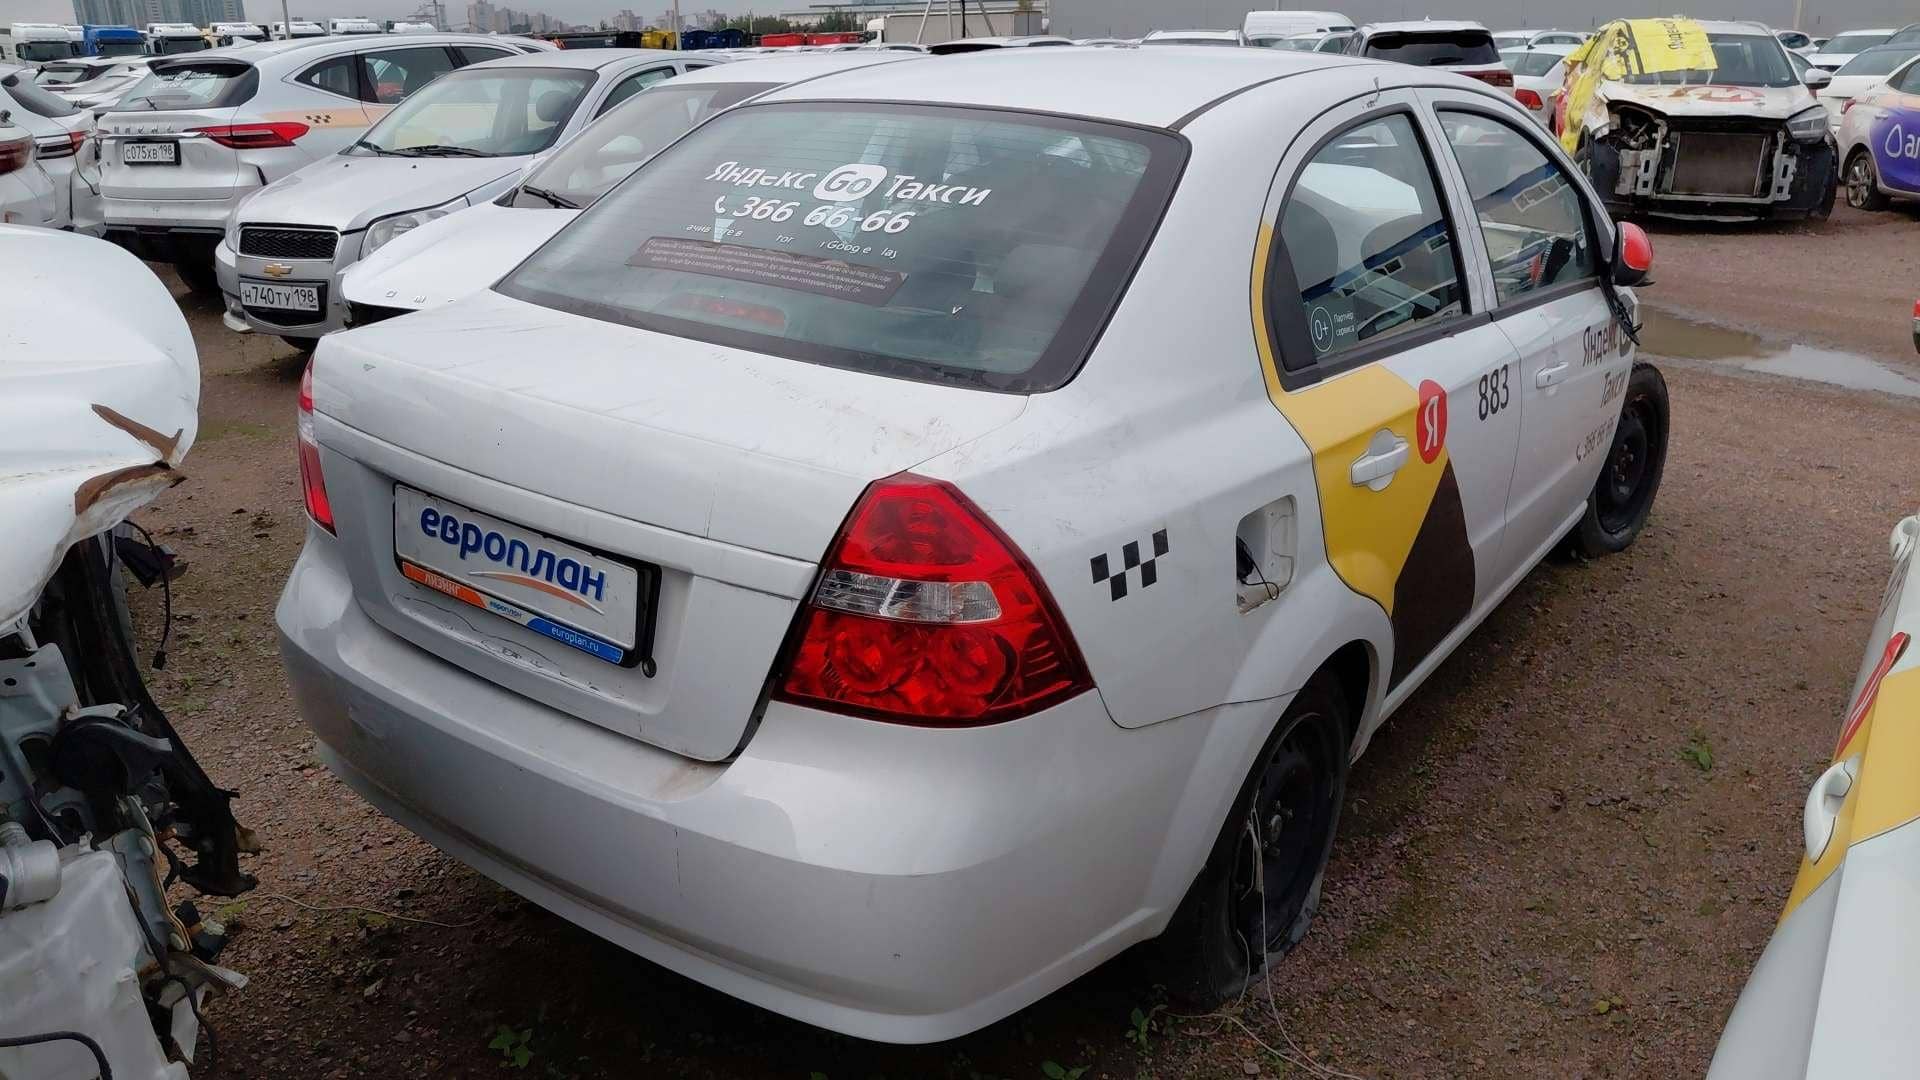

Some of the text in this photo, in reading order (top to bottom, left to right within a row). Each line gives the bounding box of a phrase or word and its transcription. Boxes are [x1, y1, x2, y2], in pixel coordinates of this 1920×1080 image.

[824, 169, 872, 194] Go
[884, 174, 992, 206] Такси
[732, 196, 917, 234] 366 66-66
[244, 286, 315, 306] Н740ТУ 198
[1478, 364, 1509, 421] 883
[420, 506, 607, 602] европлан
[551, 626, 599, 652] europlan.ru
